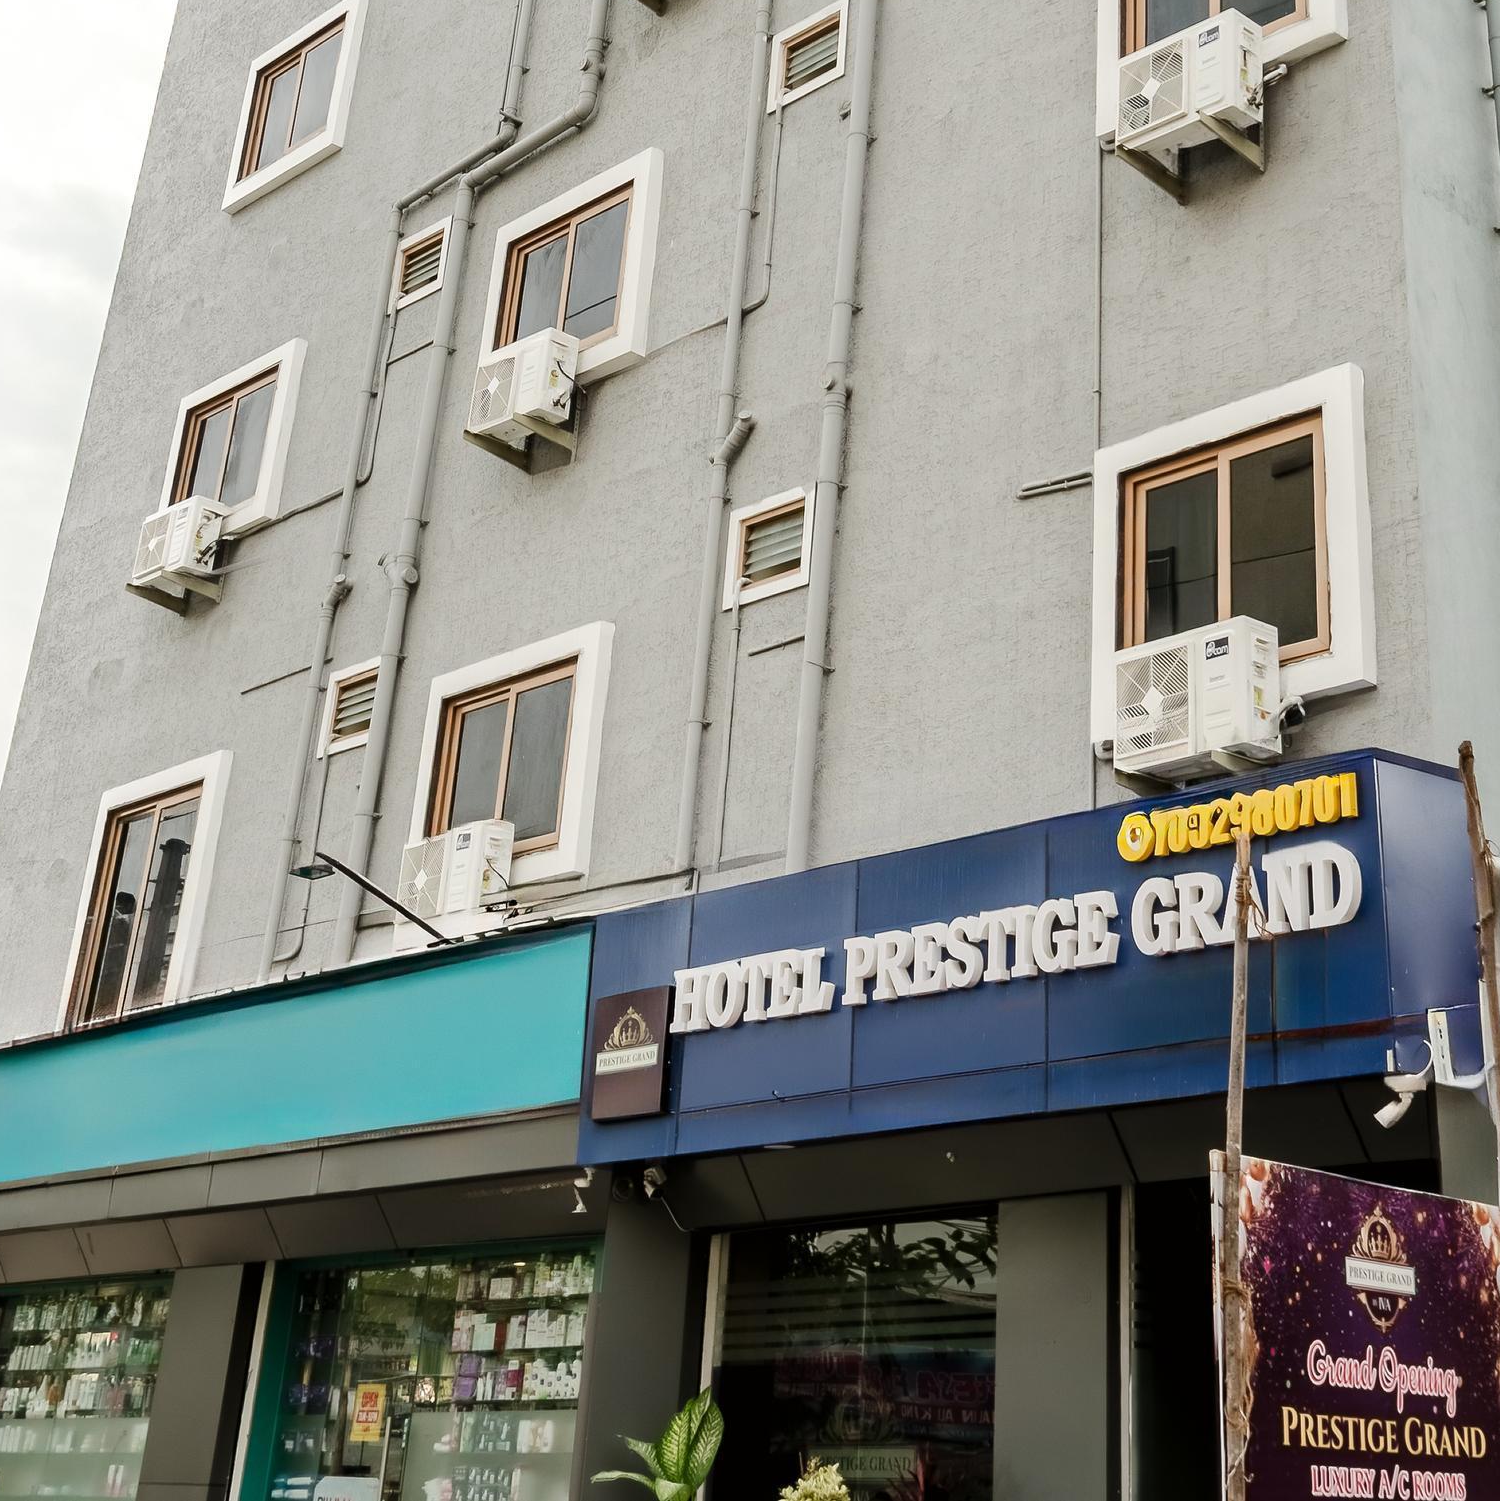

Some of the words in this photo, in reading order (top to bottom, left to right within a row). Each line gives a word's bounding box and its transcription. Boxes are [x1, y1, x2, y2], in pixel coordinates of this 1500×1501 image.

[669, 947, 834, 1033] HOTEL
[842, 890, 1120, 1006] PRESTIGE
[1131, 841, 1362, 957] GRAND
[599, 1054, 631, 1068] PRESTIGE
[632, 1050, 656, 1062] GRAND
[1348, 1265, 1384, 1282] PRESTIGE
[1386, 1273, 1412, 1286] GRAND
[1307, 1339, 1377, 1391] Grand
[1378, 1346, 1460, 1418] Opening
[1281, 1406, 1400, 1454] PRESTIGE
[1404, 1417, 1487, 1459] GRAND
[1311, 1465, 1376, 1498] LUXURY
[1378, 1464, 1410, 1500] A/C
[1412, 1470, 1467, 1501] ROOMS
